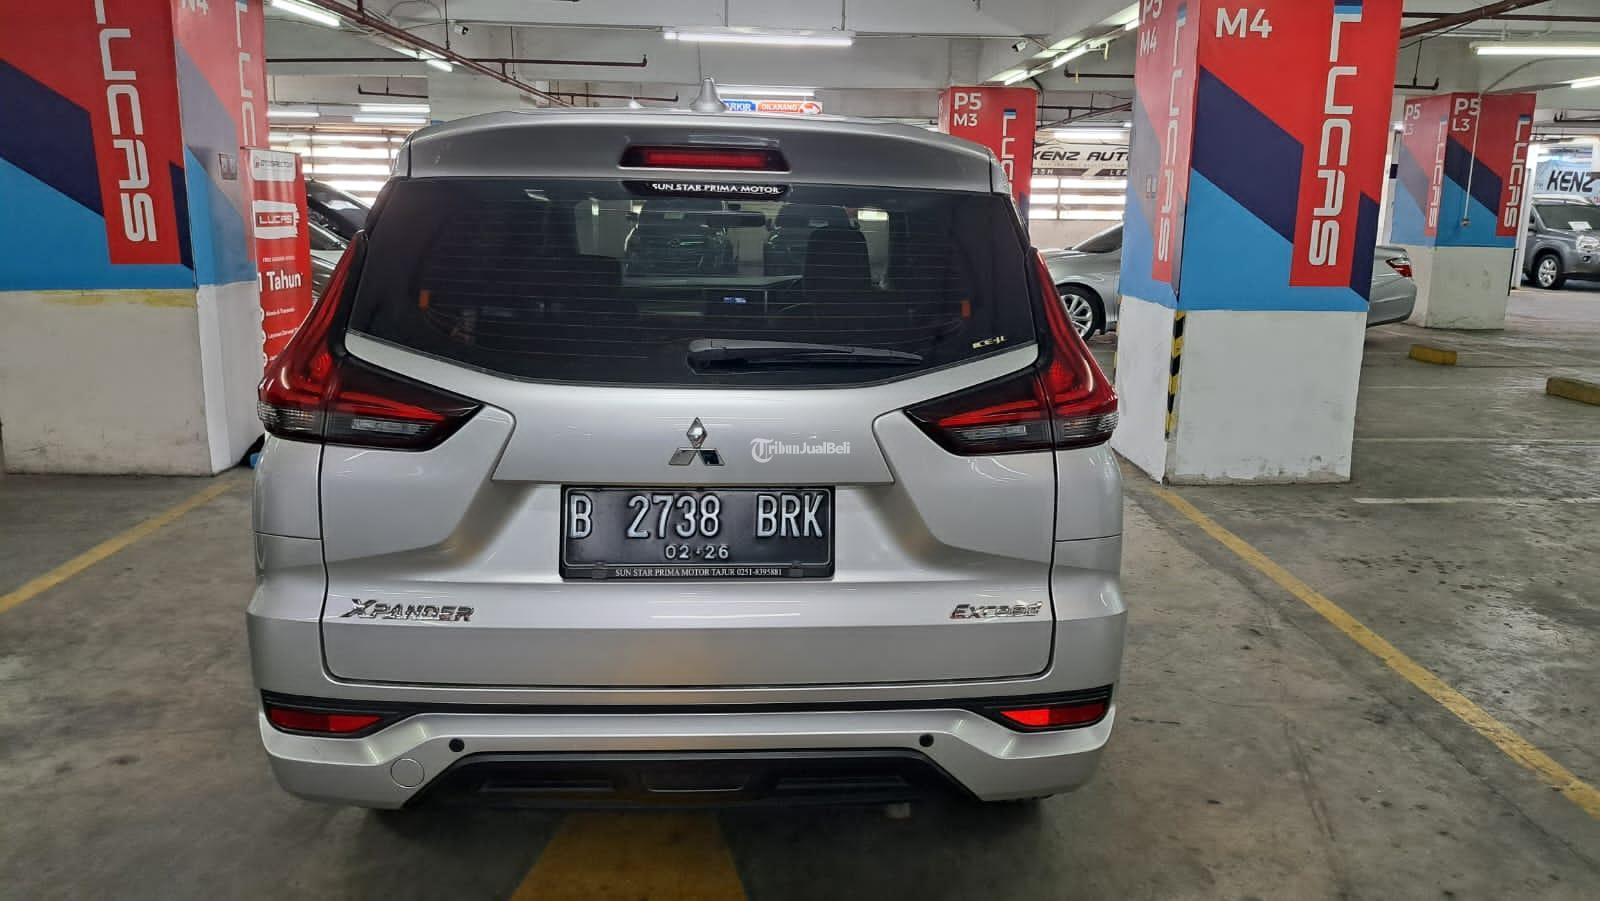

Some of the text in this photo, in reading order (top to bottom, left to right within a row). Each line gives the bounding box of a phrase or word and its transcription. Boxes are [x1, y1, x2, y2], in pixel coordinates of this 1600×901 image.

[1215, 7, 1273, 38] M4
[1139, 27, 1157, 57] M4
[235, 0, 258, 146] LUC
[953, 92, 983, 110] P5
[1404, 104, 1421, 121] P5
[1454, 98, 1480, 117] P5
[953, 113, 978, 127] M3
[1452, 118, 1471, 132] L3
[1158, 17, 1186, 262] LUCAS
[1308, 14, 1362, 266] LUCAS
[1087, 151, 1128, 161] AUT
[1429, 120, 1447, 227] LUCAS
[1504, 120, 1531, 228] LUCAS
[1546, 170, 1593, 193] KENZ
[675, 184, 701, 192] STAR
[704, 184, 738, 193] PRIMA
[740, 186, 780, 194] MOTOR
[259, 215, 293, 225] LUCAS
[570, 494, 824, 539] B 2738 BRK
[615, 568, 632, 577] SUN
[633, 568, 653, 577] STAR
[654, 568, 681, 577] PRIMA
[681, 568, 710, 577] MOTOR
[711, 568, 735, 577] TAJUR
[340, 598, 475, 622] XPANDER
